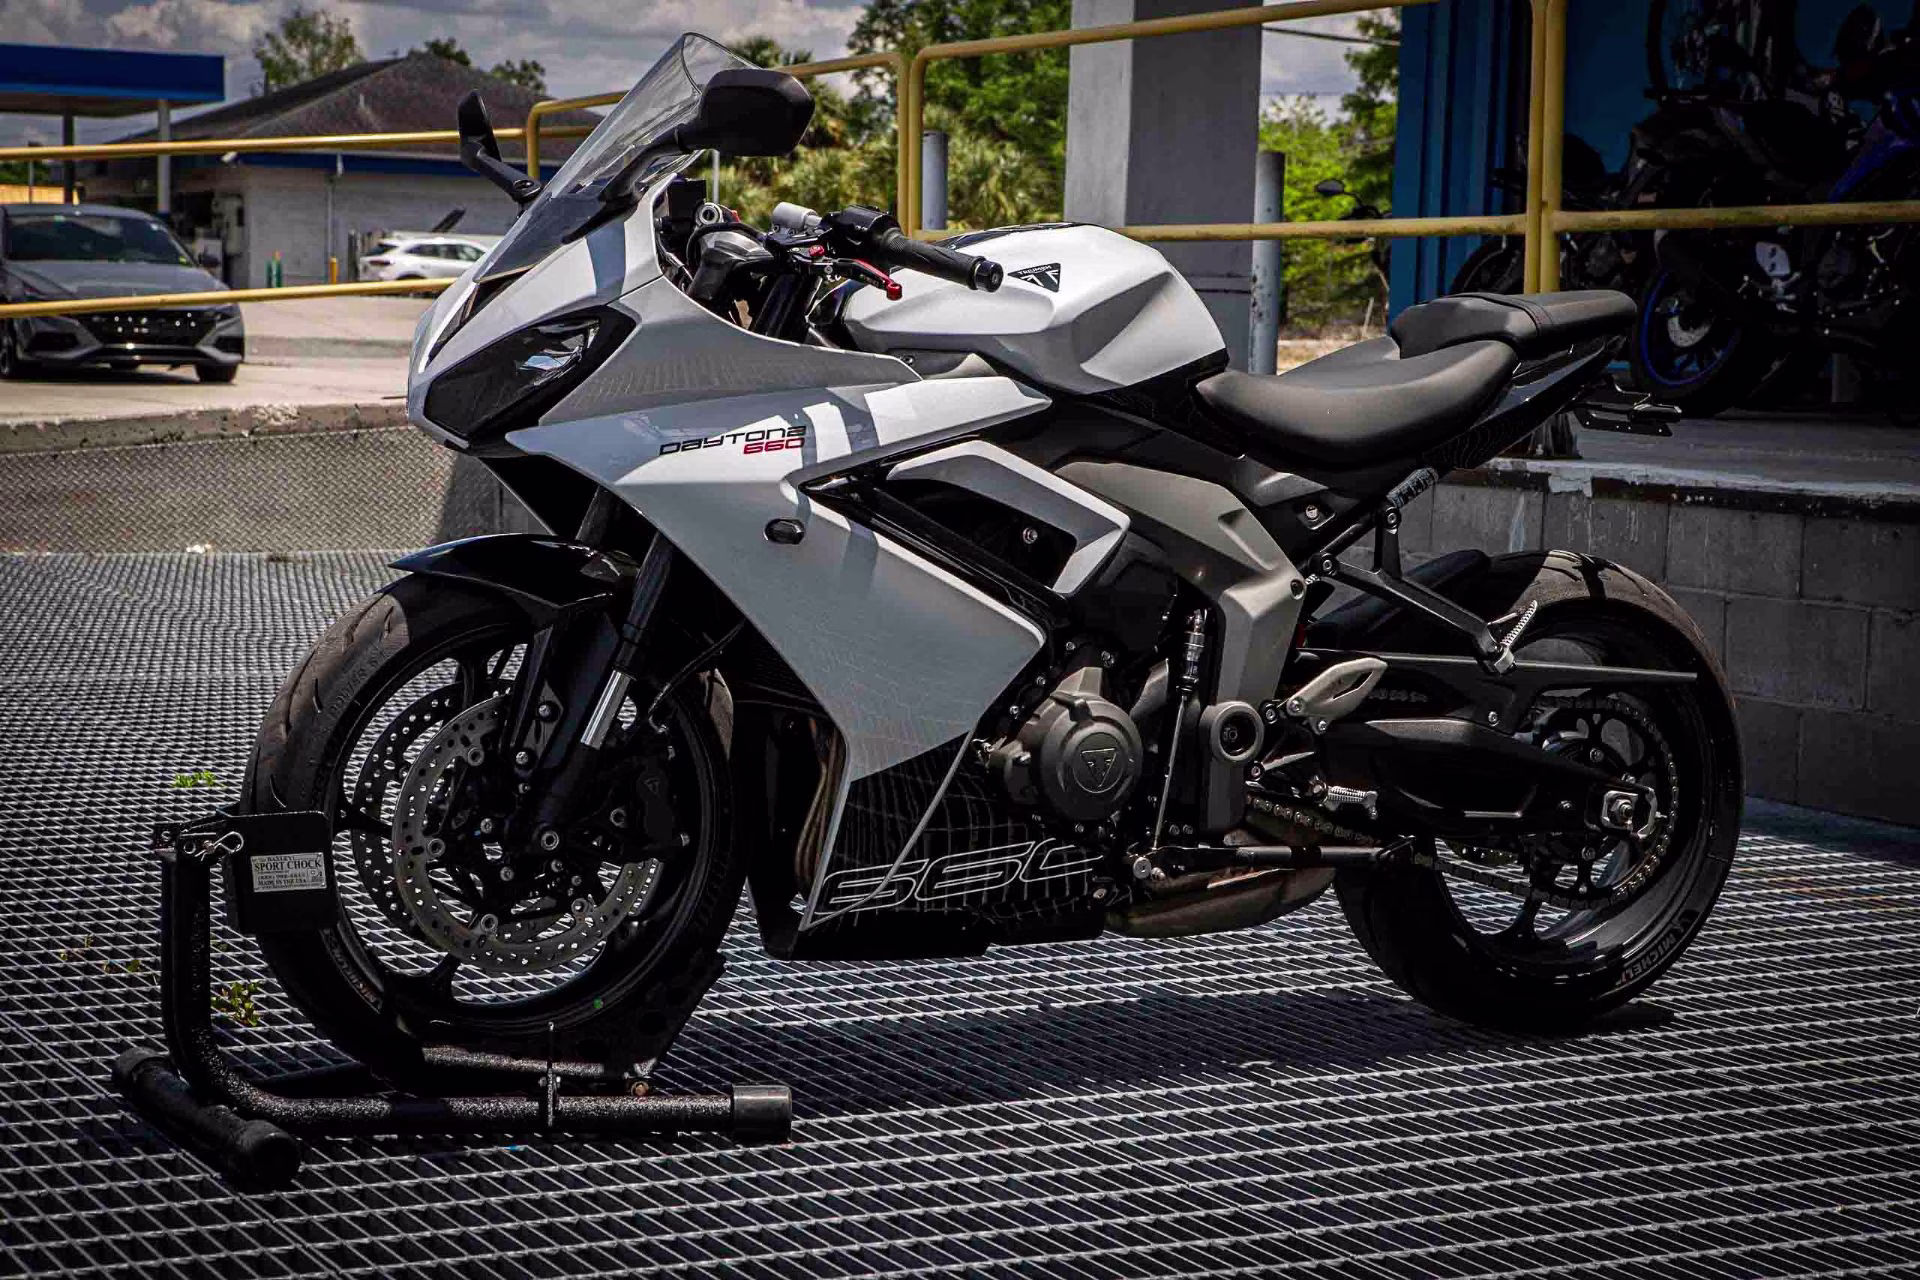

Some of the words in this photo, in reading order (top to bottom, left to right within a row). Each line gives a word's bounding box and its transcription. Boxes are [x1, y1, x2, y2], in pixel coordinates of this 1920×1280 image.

[743, 437, 806, 455] 660
[254, 861, 285, 871] SPORT
[287, 859, 322, 869] CHOCK
